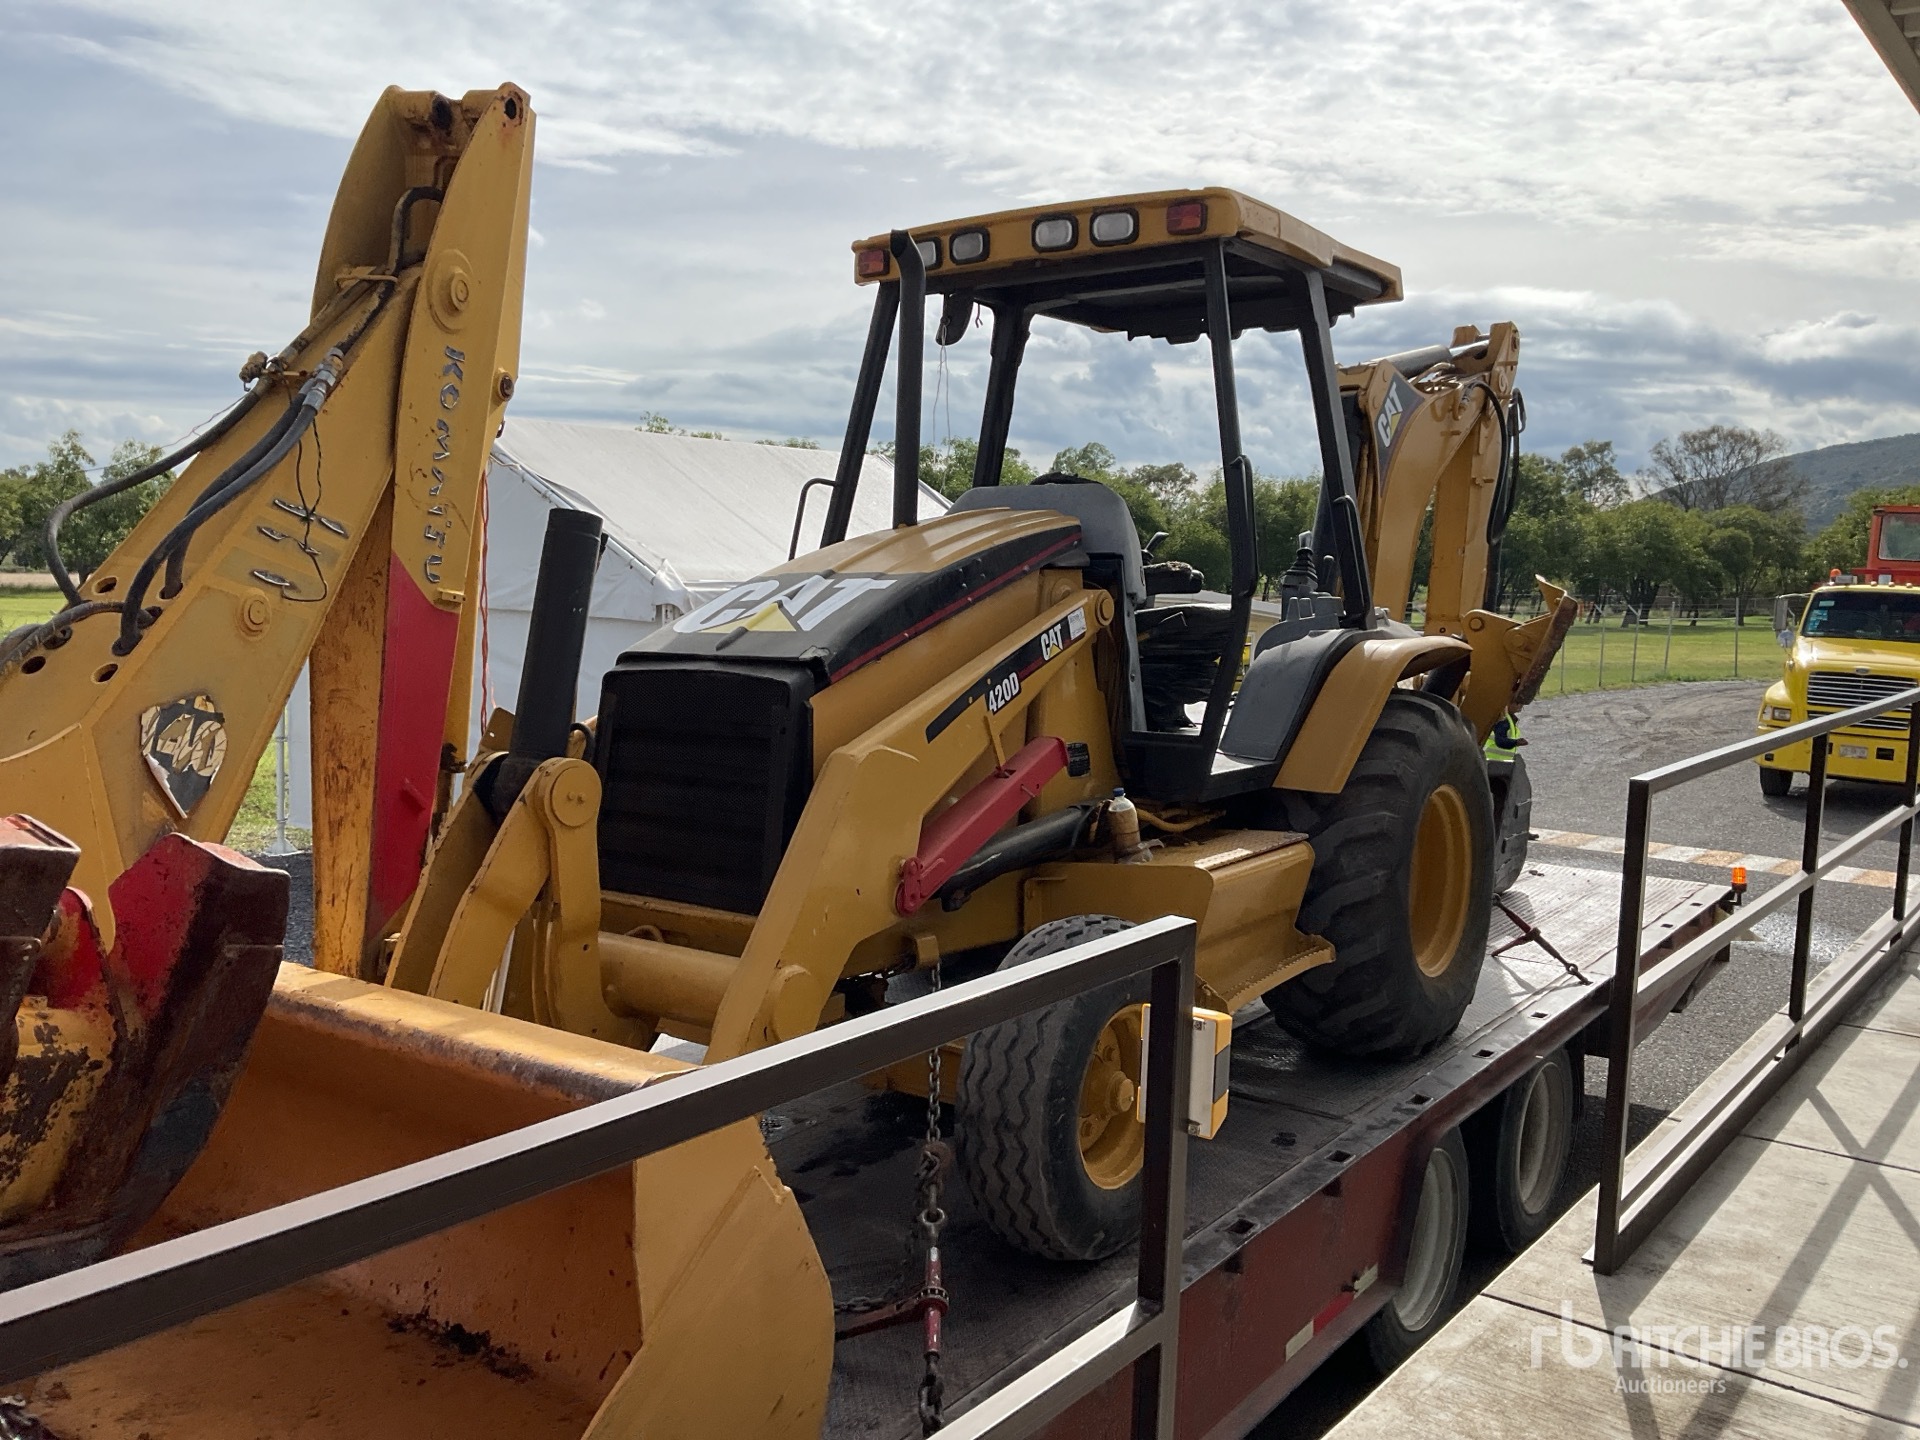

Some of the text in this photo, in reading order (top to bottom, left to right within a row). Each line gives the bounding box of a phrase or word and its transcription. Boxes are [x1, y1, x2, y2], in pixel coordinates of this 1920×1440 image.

[1377, 381, 1403, 448] CAT
[673, 574, 898, 633] CAT
[1041, 623, 1063, 661] CAT
[988, 671, 1020, 712] 420D
